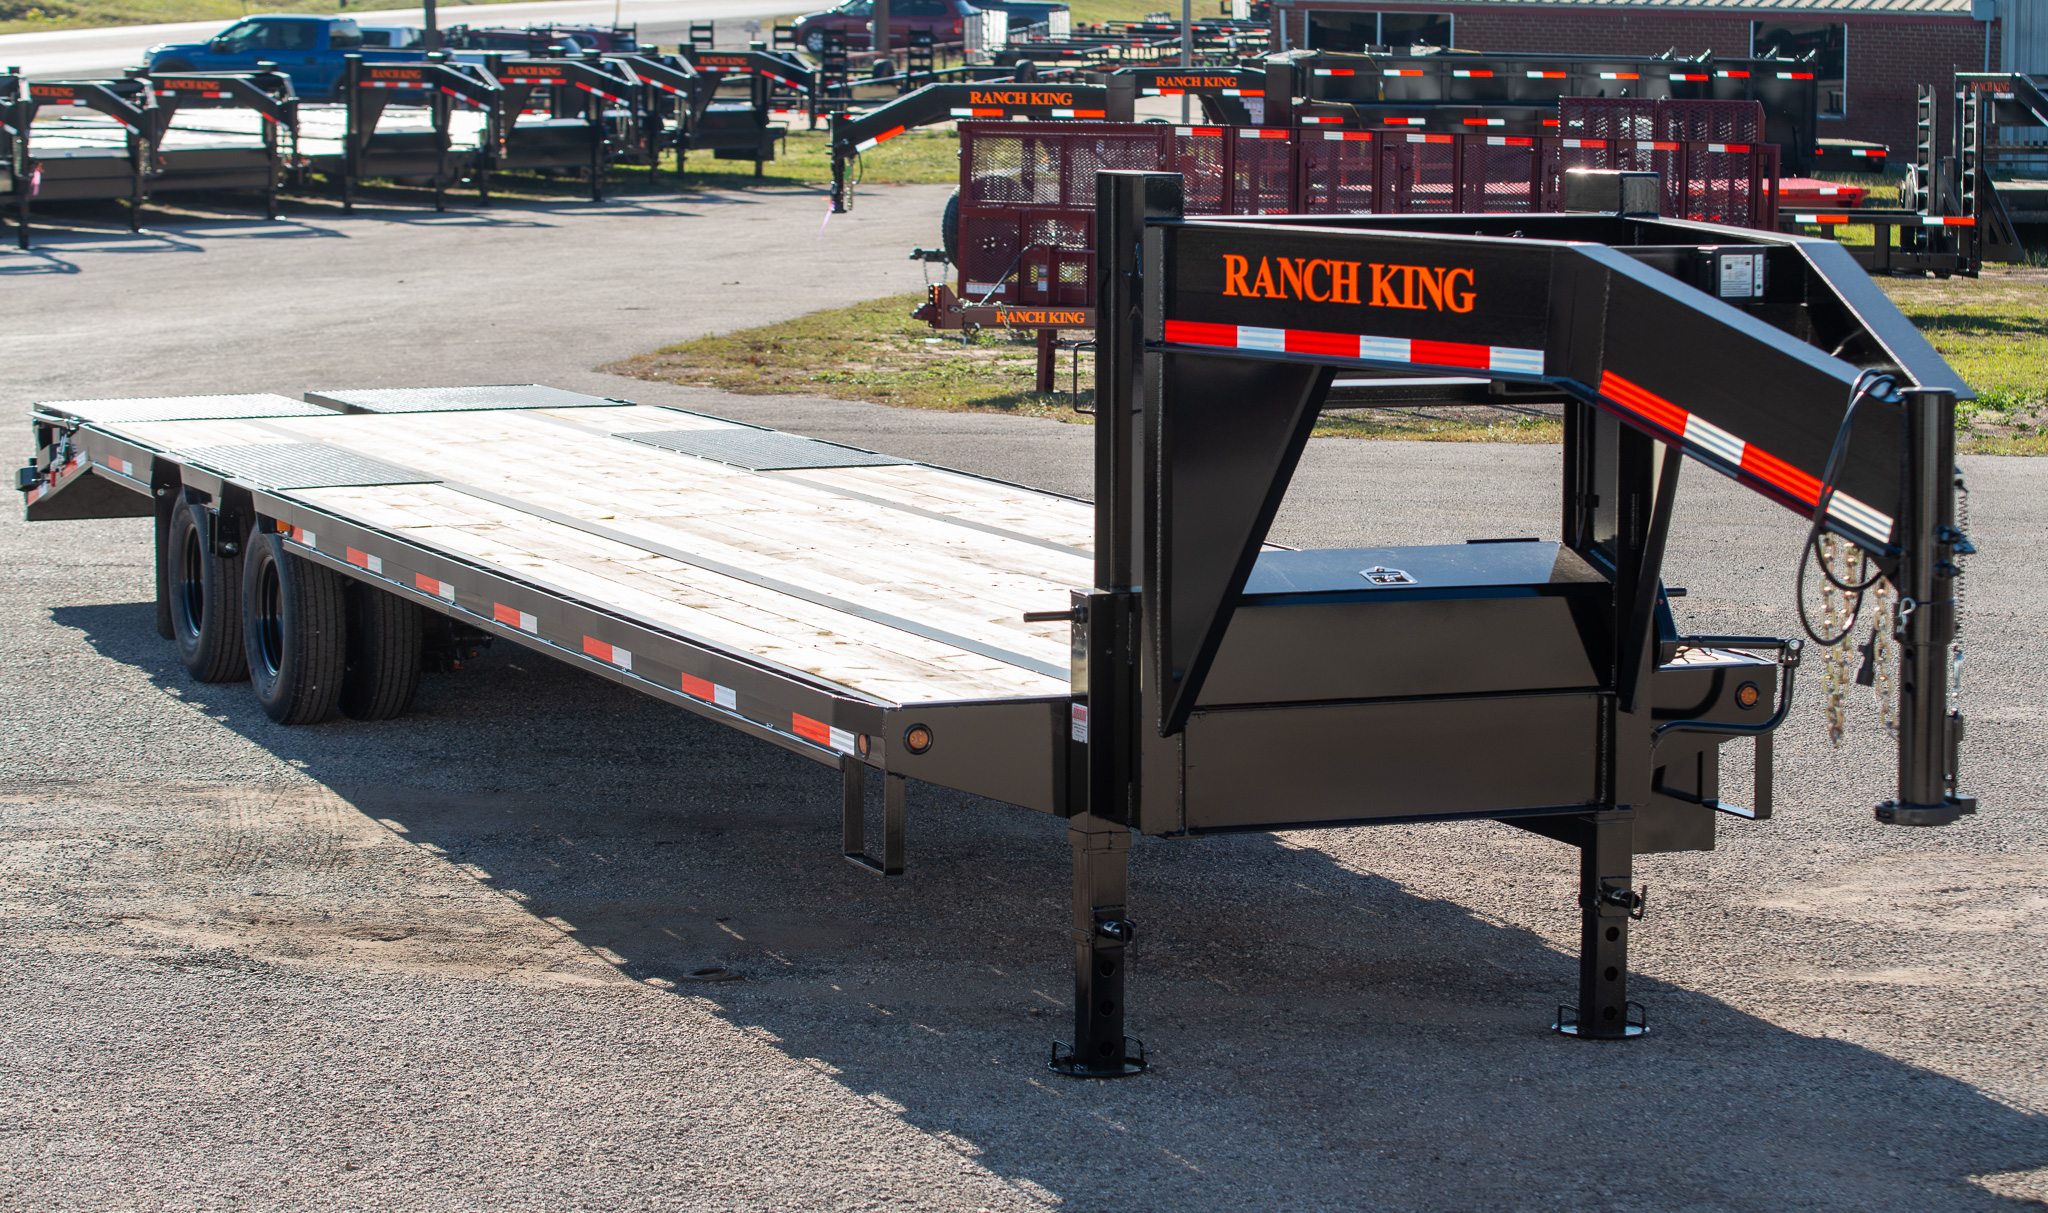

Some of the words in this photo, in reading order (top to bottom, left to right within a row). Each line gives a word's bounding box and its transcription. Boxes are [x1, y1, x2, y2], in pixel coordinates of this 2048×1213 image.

[164, 80, 196, 89] RANCH
[196, 81, 220, 90] KING
[1156, 76, 1202, 87] RANCH
[1203, 76, 1237, 87] KING
[969, 91, 1027, 105] RANCH
[1030, 92, 1073, 106] KING
[1222, 253, 1362, 305] RANCH
[1368, 263, 1477, 314] KING
[995, 310, 1046, 323] RANCH
[1048, 312, 1086, 324] KING
